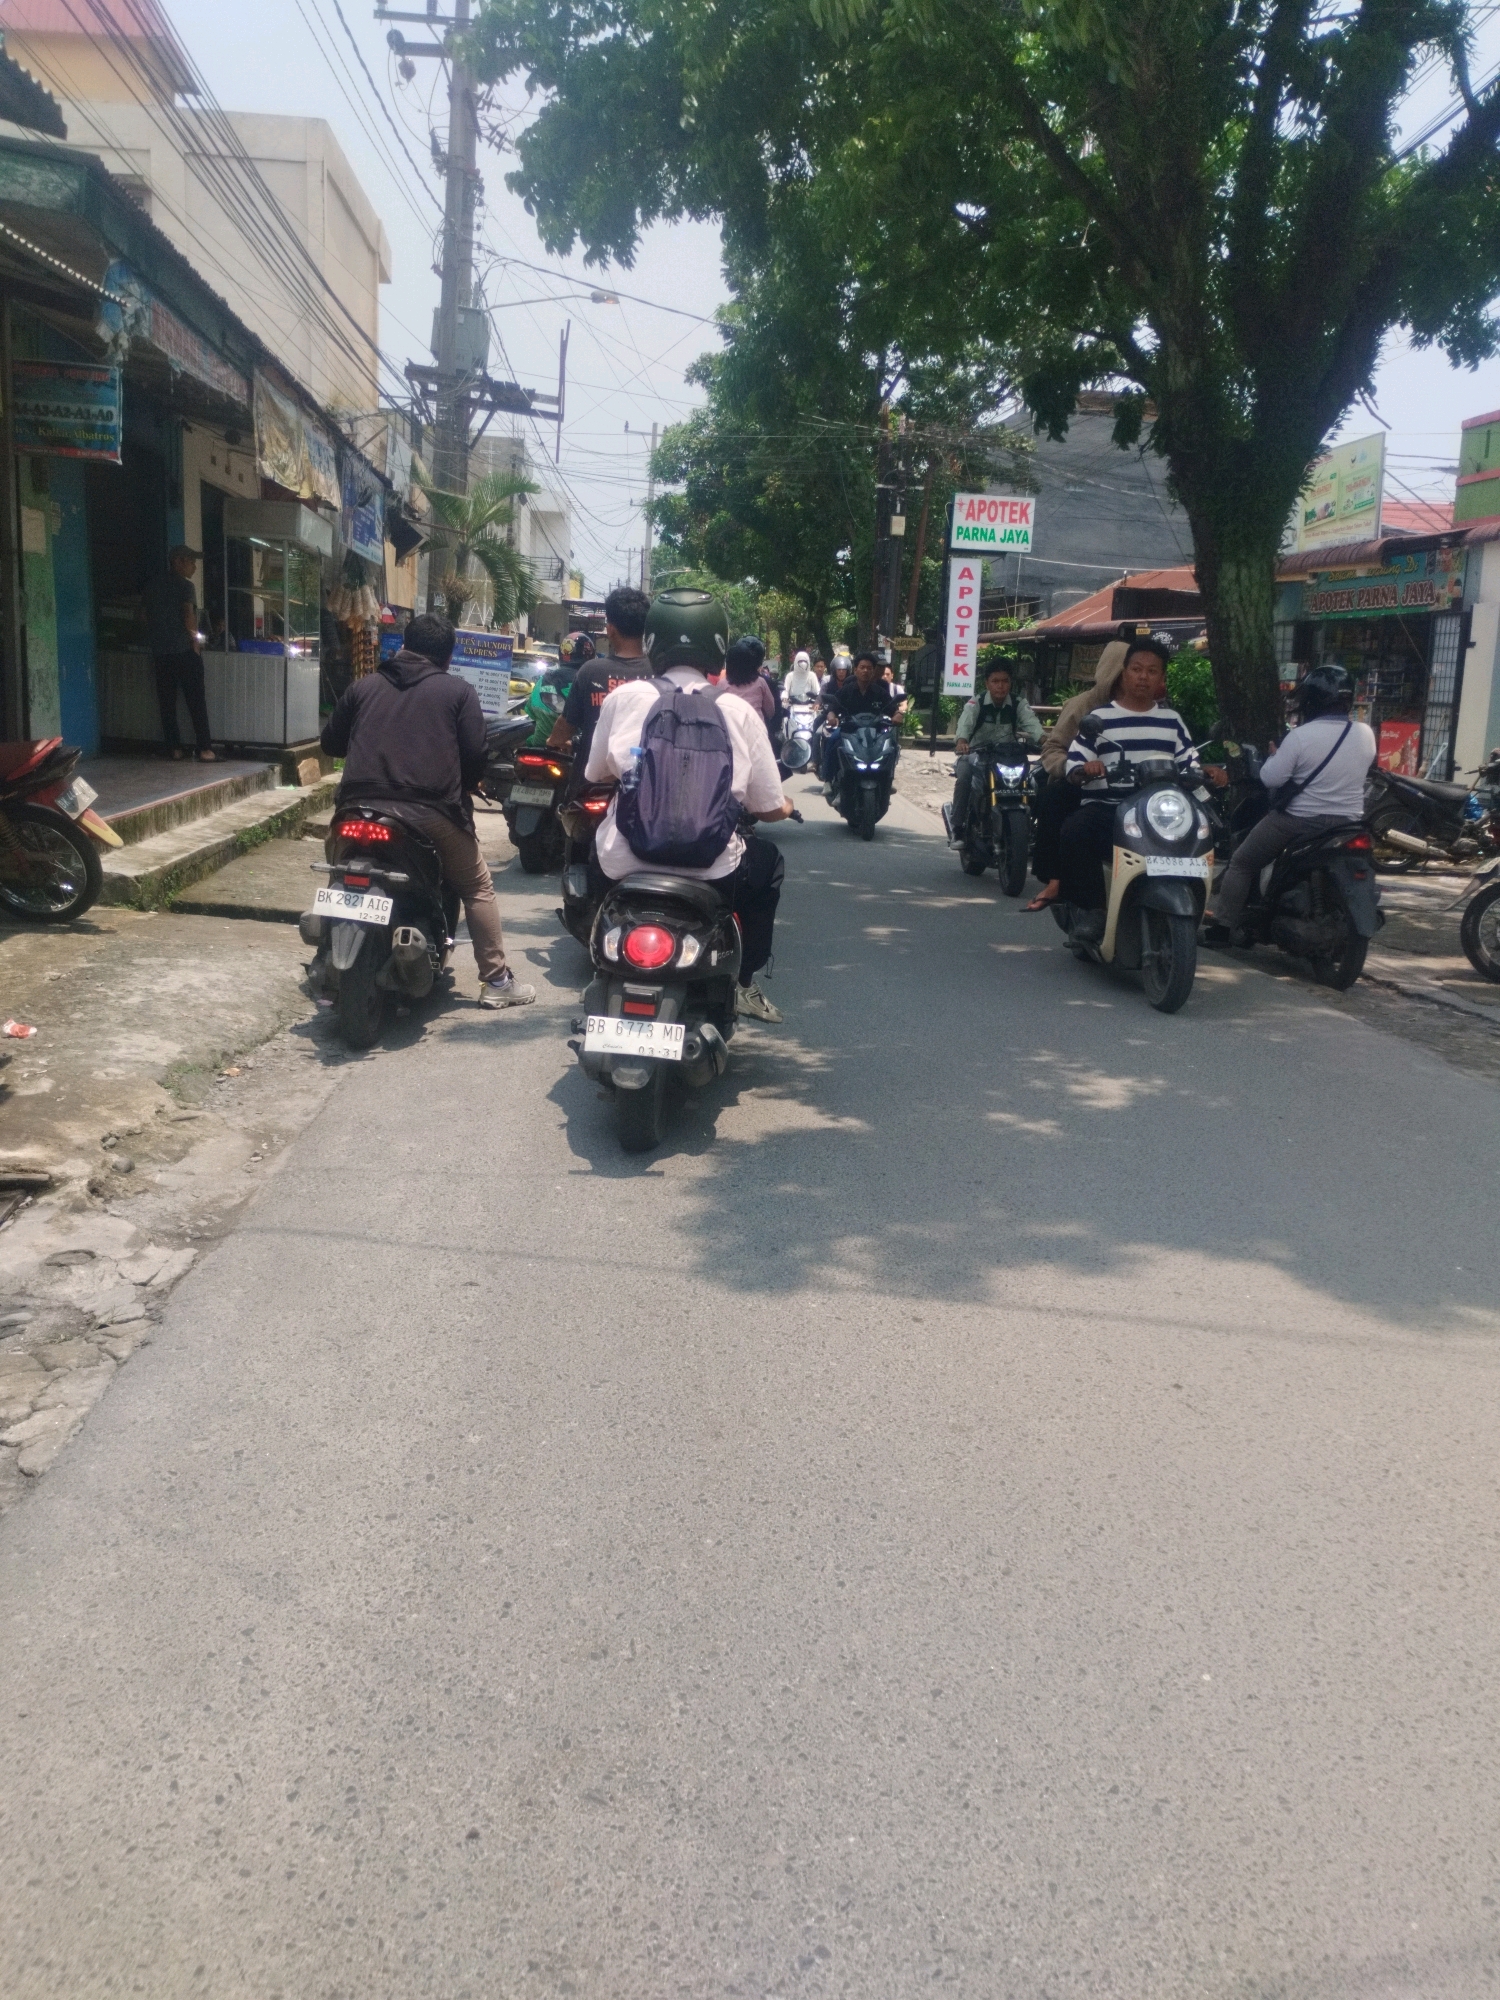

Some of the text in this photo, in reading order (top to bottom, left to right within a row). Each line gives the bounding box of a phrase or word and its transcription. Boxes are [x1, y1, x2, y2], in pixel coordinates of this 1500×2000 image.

[965, 498, 1031, 525] APOTEK
[956, 525, 1029, 545] PARNA JAYA
[1310, 579, 1437, 614] APOTEK PARNA JAYA
[953, 566, 975, 677] APOTEK
[463, 647, 498, 658] EXPRESS
[477, 640, 513, 651] LAUNDRY
[947, 681, 961, 689] PARNA
[317, 890, 390, 912] BK 2821 AIG
[587, 1018, 683, 1042] BB 6773 MD
